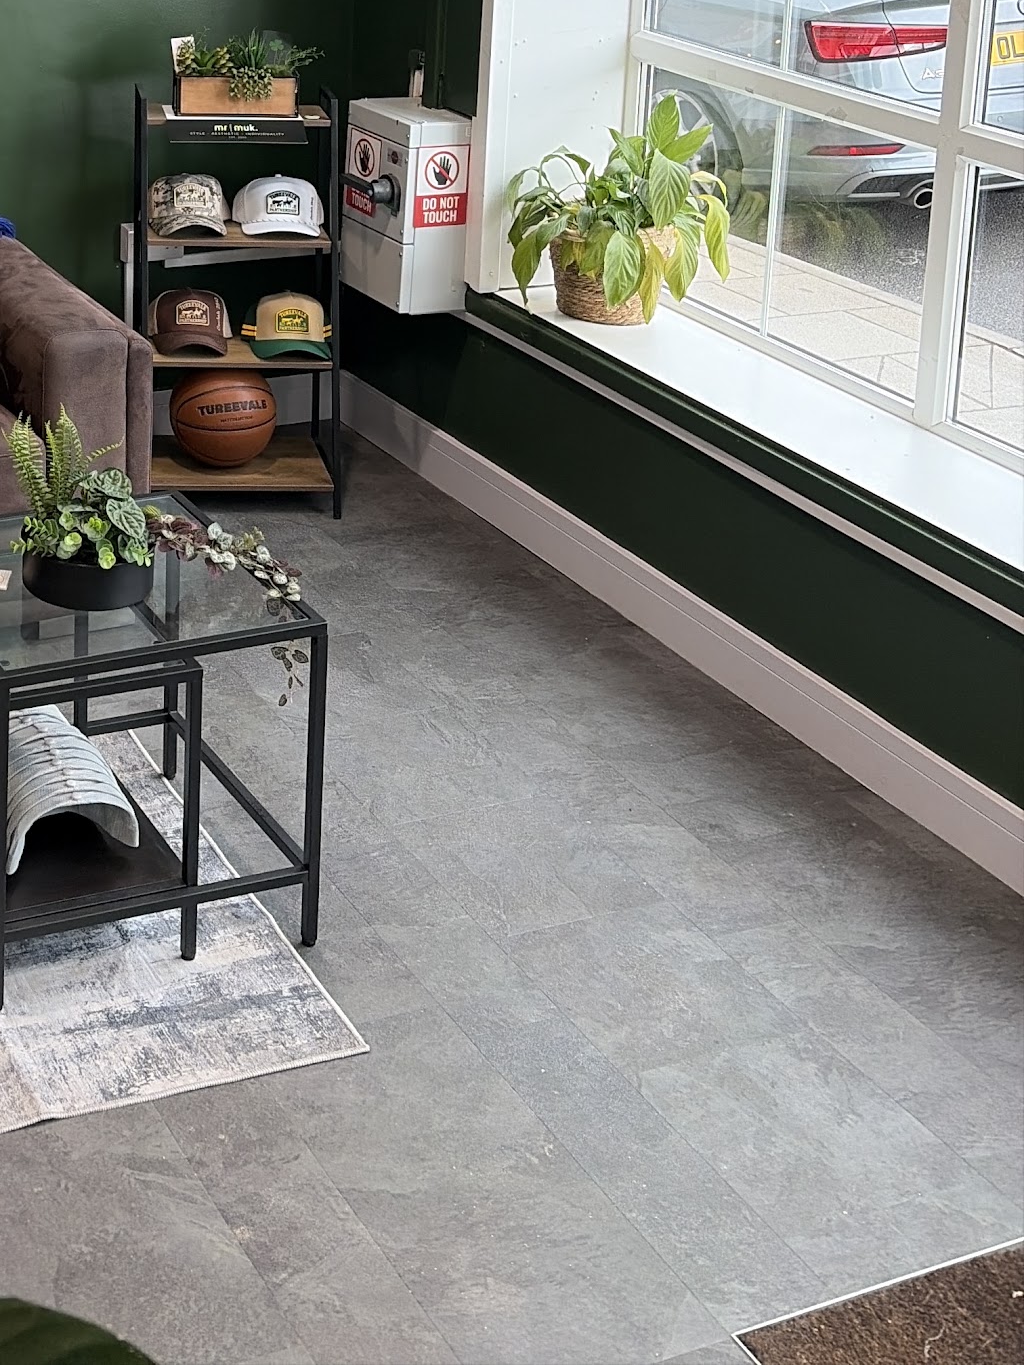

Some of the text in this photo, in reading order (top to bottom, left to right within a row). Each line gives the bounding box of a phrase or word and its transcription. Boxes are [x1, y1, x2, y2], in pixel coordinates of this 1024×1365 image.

[351, 192, 372, 213] TOUCH
[422, 196, 460, 211] DO NOT
[423, 210, 457, 224] TOUCH
[197, 399, 268, 416] TUREEVALE
